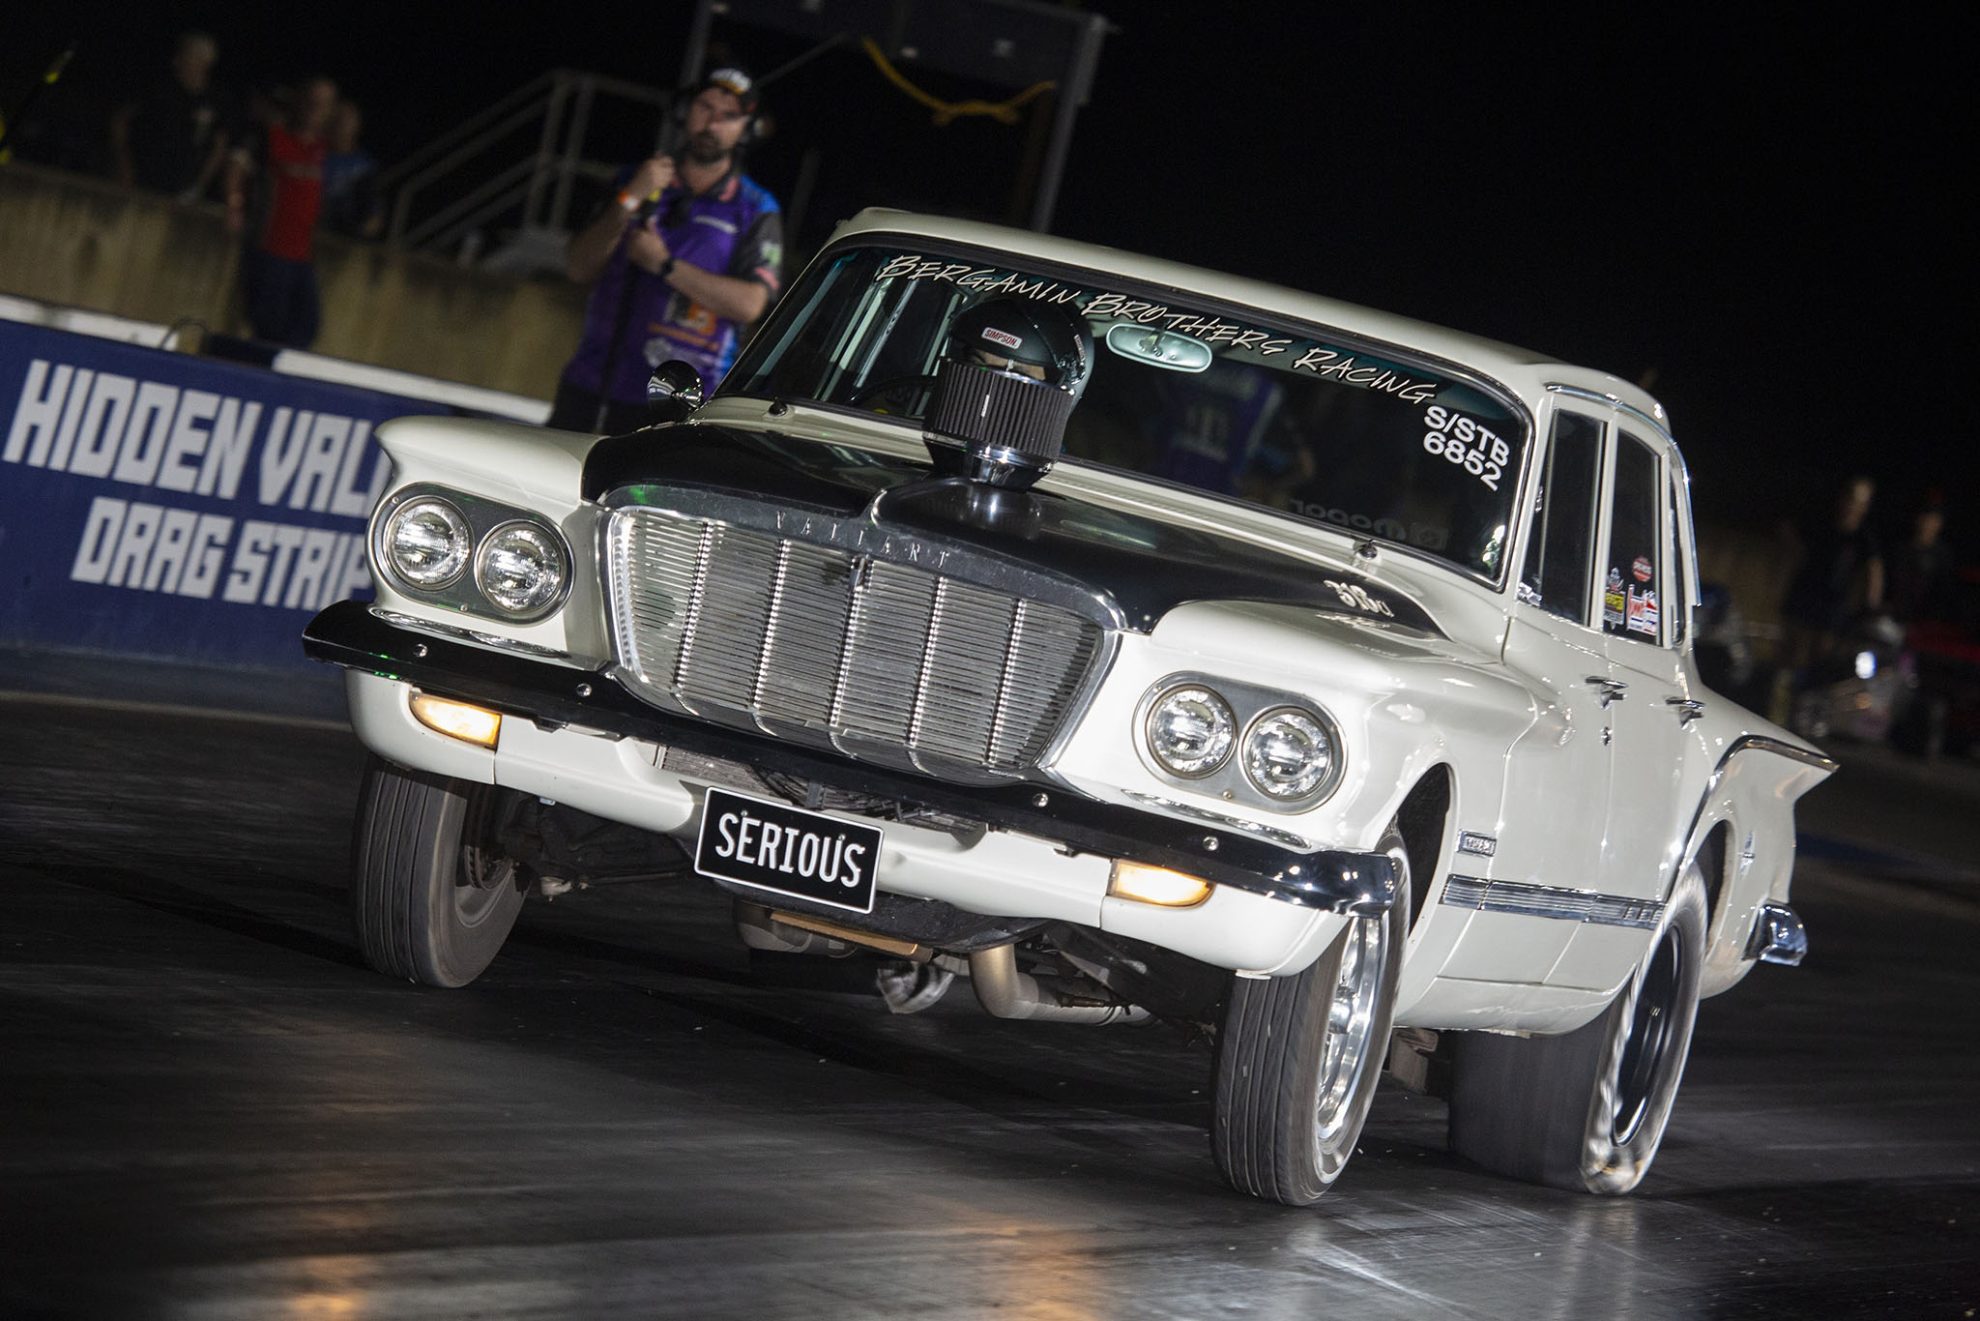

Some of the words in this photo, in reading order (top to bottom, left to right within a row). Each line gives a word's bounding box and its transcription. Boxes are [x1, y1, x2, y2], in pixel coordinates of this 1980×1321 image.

[875, 255, 1081, 305] BERGAMIN
[1080, 292, 1295, 356] BROTHERS
[1293, 347, 1437, 405] RACING
[985, 329, 1018, 346] SIMPSON
[2, 358, 263, 500] HIDDEN
[1423, 405, 1510, 467] S/STB
[1423, 431, 1502, 492] 6852
[70, 496, 234, 599] DRAG
[222, 519, 374, 611] STRIP
[714, 812, 866, 889] SERIOUS
